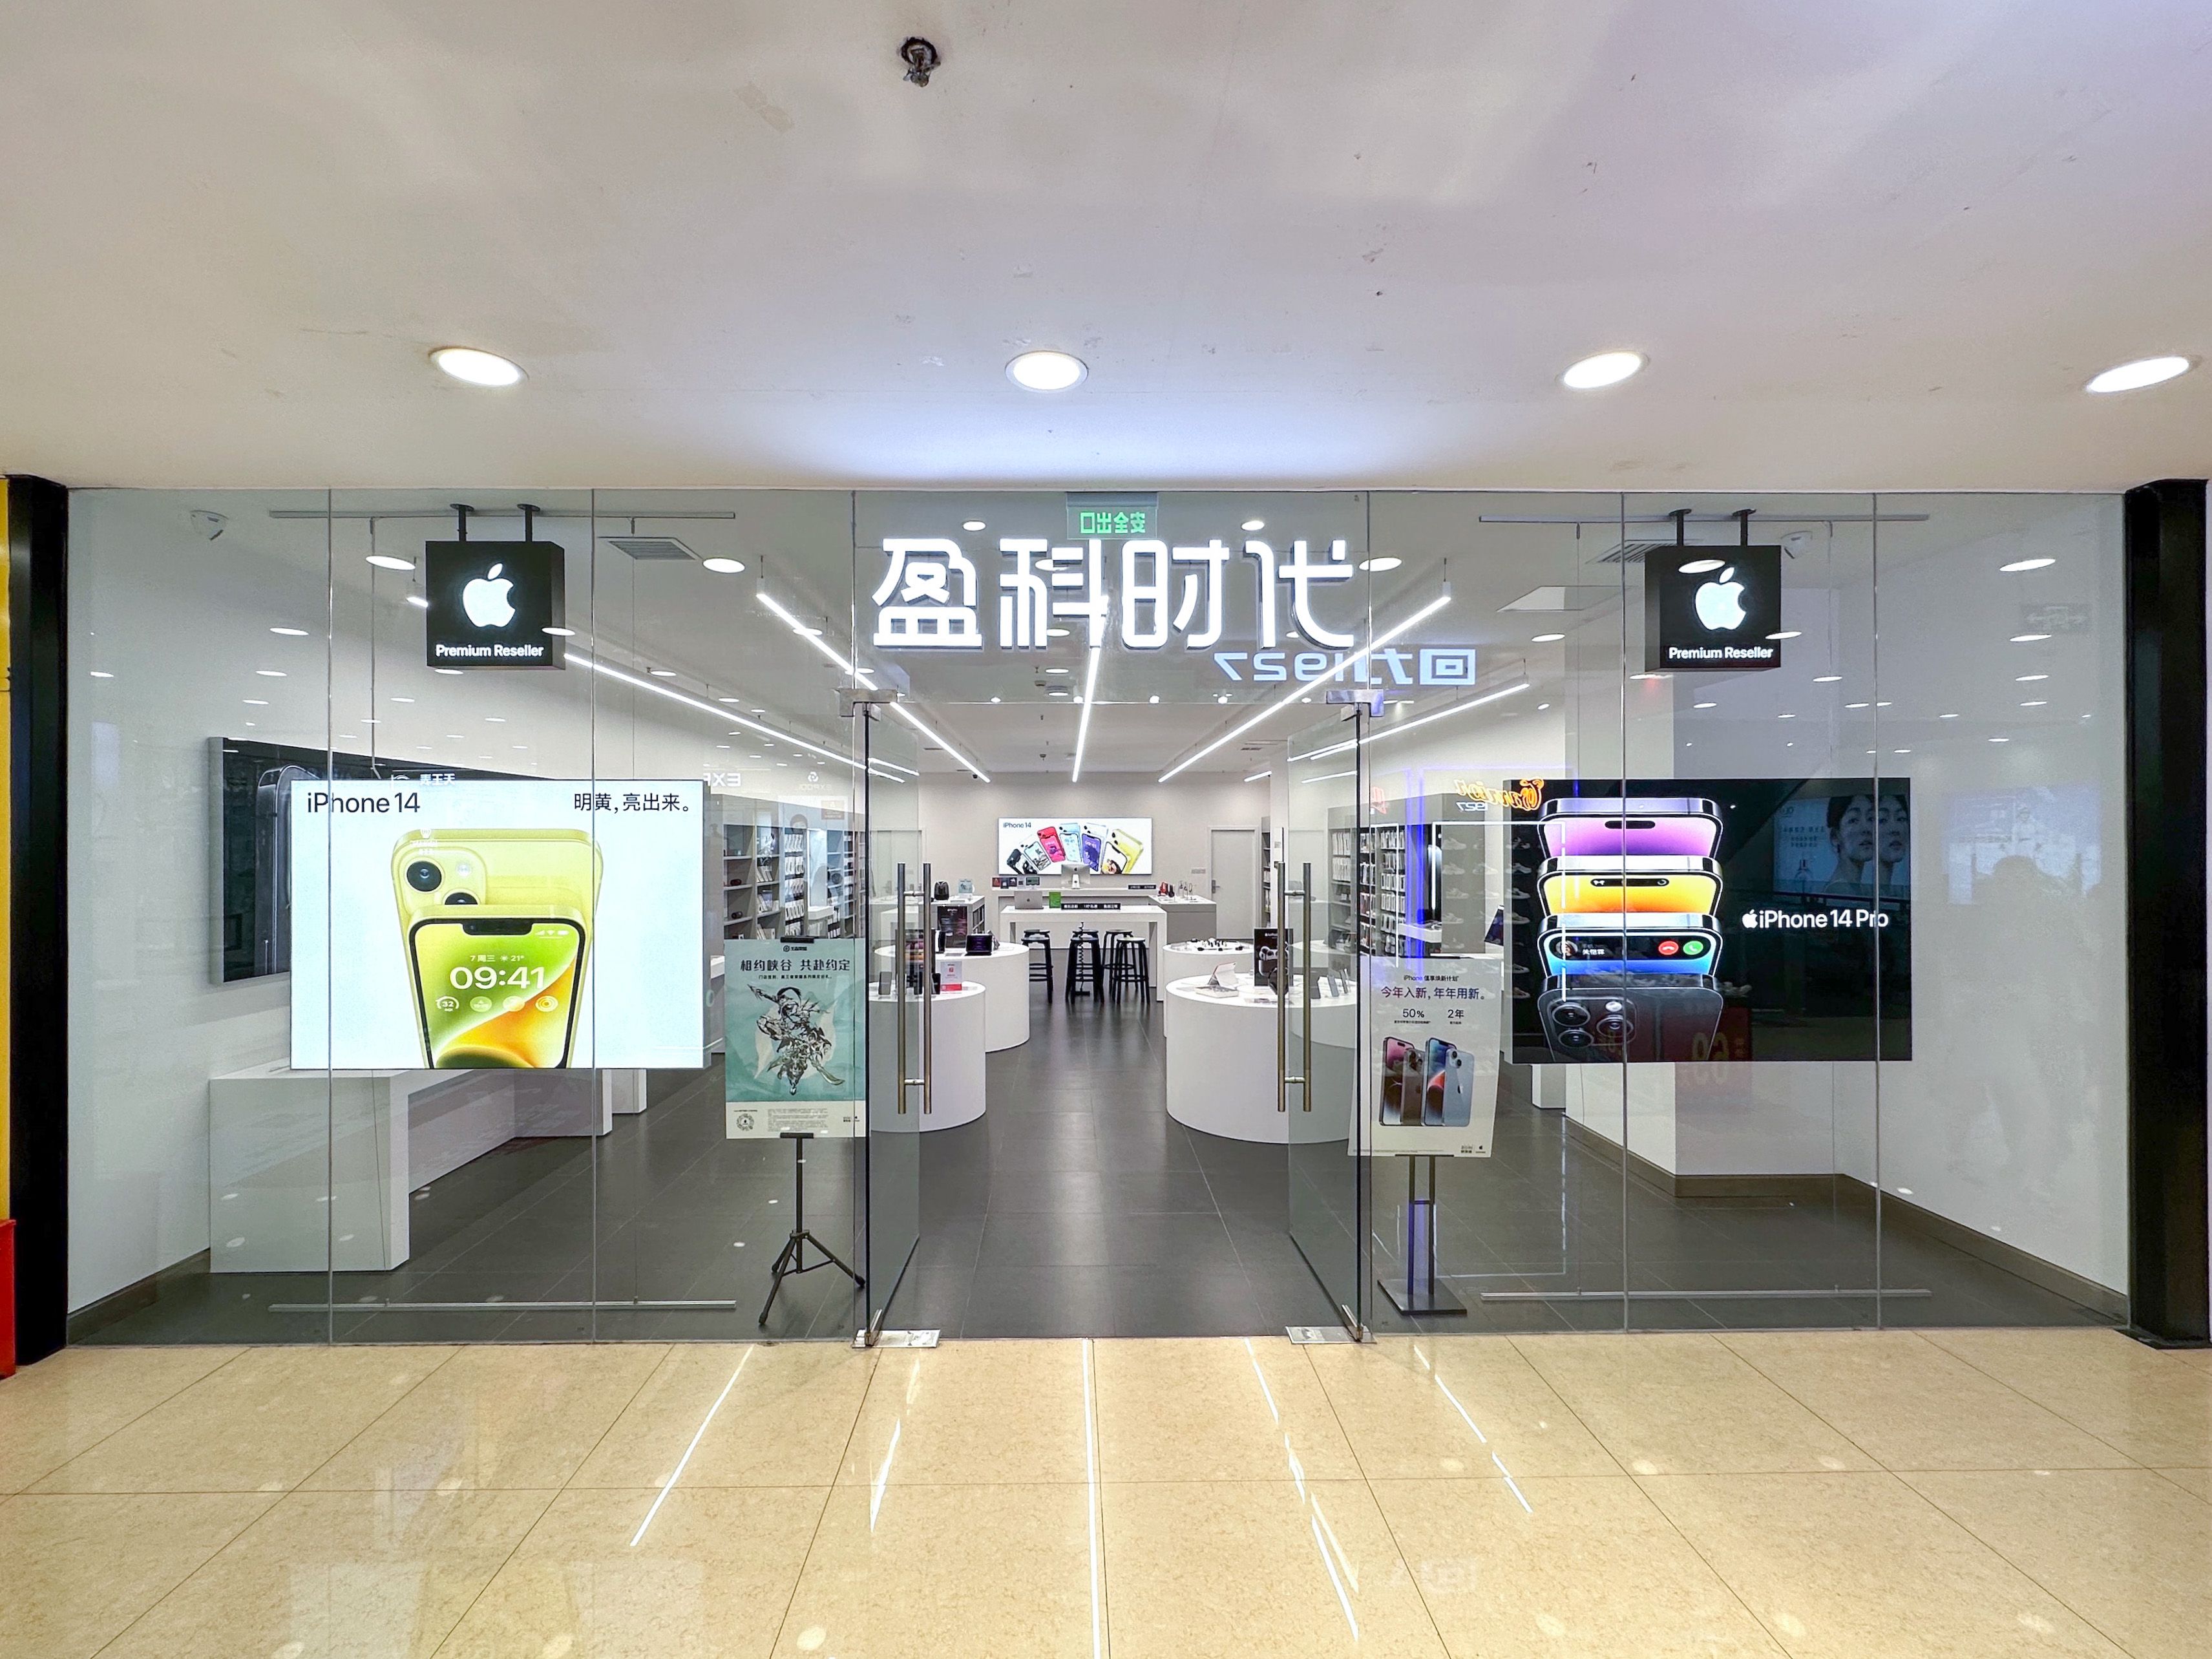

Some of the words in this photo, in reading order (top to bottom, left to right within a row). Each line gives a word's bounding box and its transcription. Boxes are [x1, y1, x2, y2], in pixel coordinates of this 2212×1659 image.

[872, 538, 1356, 649] 盈科时代
[436, 644, 492, 657] Premium
[494, 644, 545, 657] Reseller
[1669, 646, 1723, 659] Premium
[1724, 646, 1774, 659] Reseller
[307, 792, 390, 814] iPhone
[394, 792, 421, 813] 14
[1759, 910, 1828, 929] iPhone
[1829, 909, 1853, 927] 14
[1856, 909, 1890, 927] Pro
[741, 959, 792, 971] 相约峡谷
[800, 959, 850, 971] 共赴约定
[449, 966, 545, 989] 09:41
[1402, 1008, 1425, 1019] 50%
[1448, 1009, 1464, 1019] 2年
